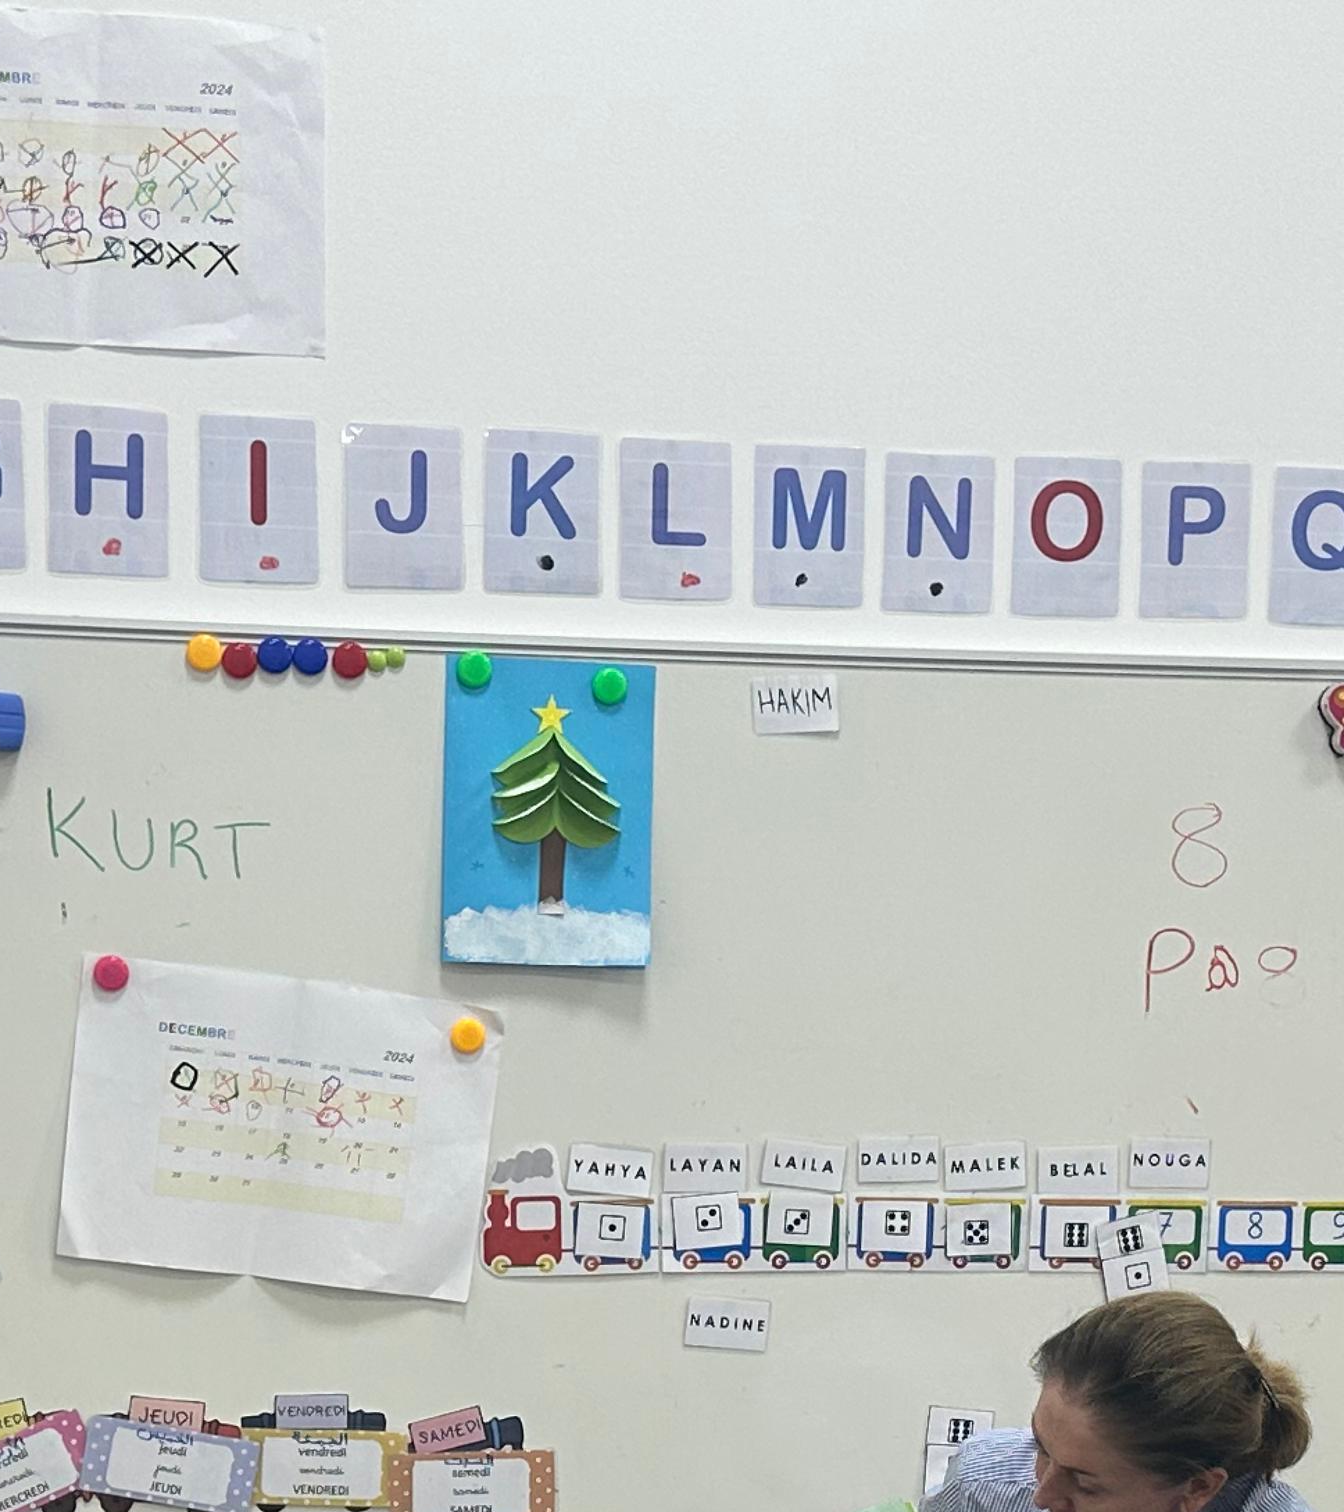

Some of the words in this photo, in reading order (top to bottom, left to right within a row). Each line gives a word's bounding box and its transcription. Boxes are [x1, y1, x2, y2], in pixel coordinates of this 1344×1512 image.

[199, 83, 234, 96] 2024
[75, 429, 144, 519] H
[250, 439, 267, 526] I
[375, 449, 428, 534] J
[512, 452, 577, 540] K
[652, 462, 707, 547] L
[772, 468, 847, 551] M
[907, 474, 973, 560] N
[1031, 479, 1104, 562] O
[1168, 485, 1226, 566] P
[756, 687, 833, 718] HAKIM
[46, 787, 271, 879] KURT
[1172, 803, 1227, 887] 8
[159, 1021, 235, 1040] DECEMBRE
[384, 1050, 415, 1064] 2024
[670, 1157, 741, 1173] LAYAN
[774, 1153, 834, 1175] LAILA
[860, 1151, 937, 1166] DALIDA
[950, 1155, 1021, 1173] MALEK
[1133, 1153, 1206, 1167] NOUGA
[573, 1158, 647, 1181] YAHYA
[1050, 1162, 1108, 1177] BELAL
[1248, 1212, 1263, 1238] 8
[689, 1313, 766, 1333] NADINE
[138, 1409, 193, 1426] JEUDI
[277, 1405, 346, 1417] VENDREDI
[418, 1419, 481, 1444] SAMEDI
[149, 1481, 182, 1495] JEUDI
[293, 1484, 349, 1496] VENDREDI
